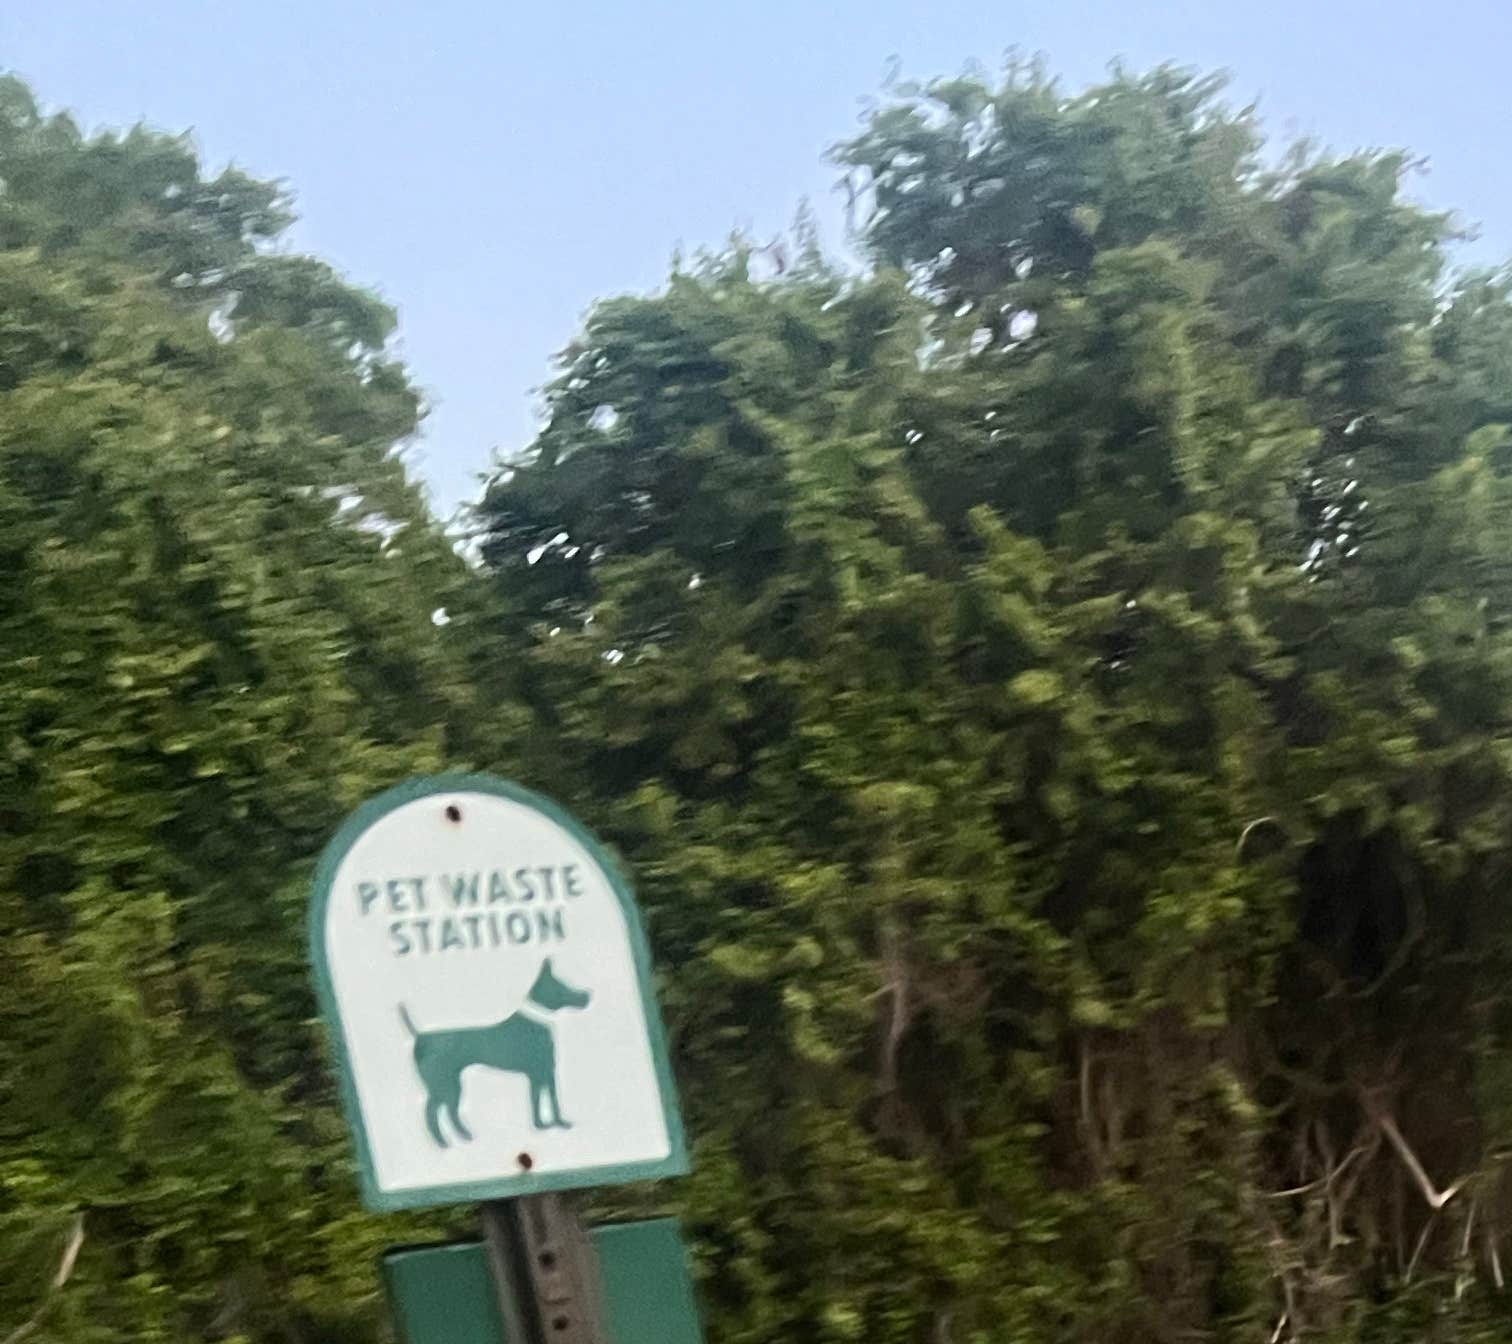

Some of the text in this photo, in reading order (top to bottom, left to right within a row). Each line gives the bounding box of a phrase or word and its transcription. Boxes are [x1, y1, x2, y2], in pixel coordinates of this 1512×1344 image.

[357, 864, 584, 916] PET WASTE
[389, 909, 567, 956] STATION
